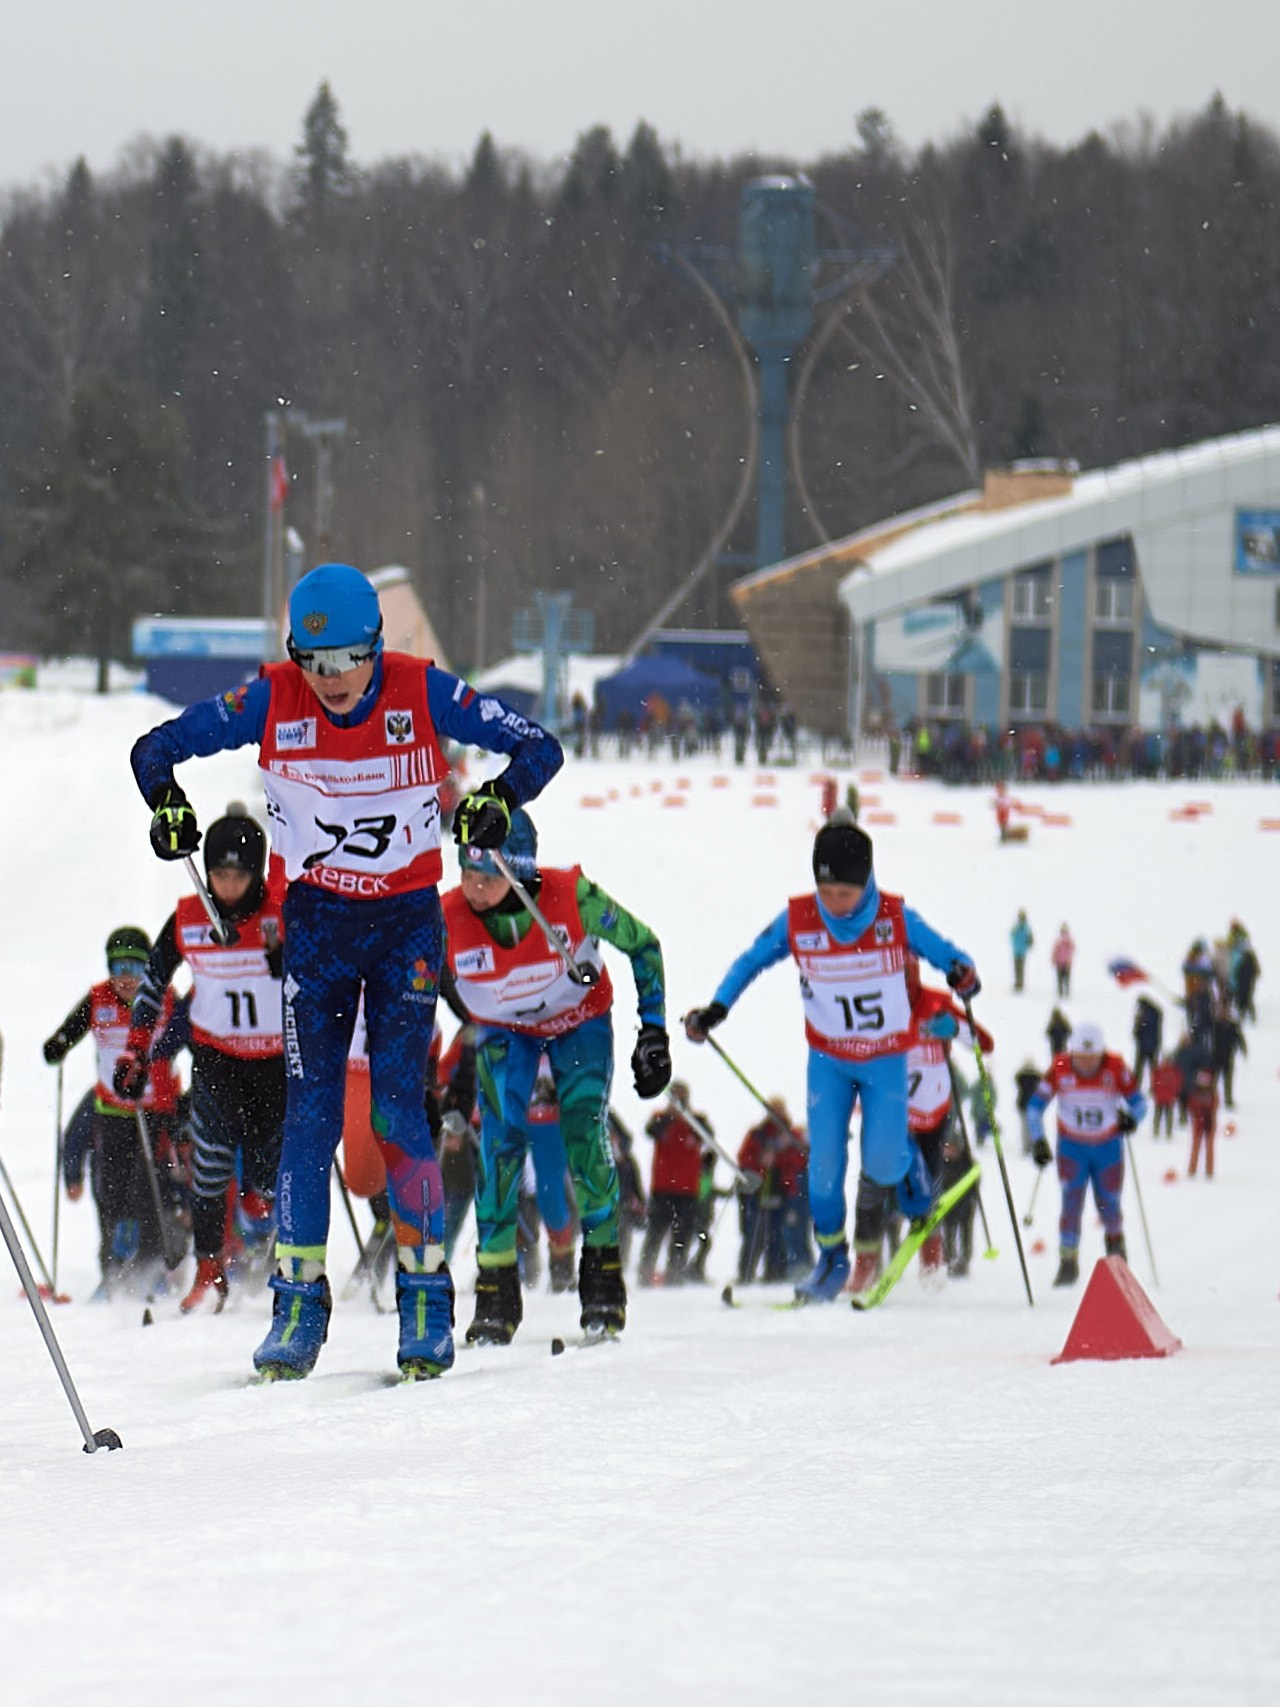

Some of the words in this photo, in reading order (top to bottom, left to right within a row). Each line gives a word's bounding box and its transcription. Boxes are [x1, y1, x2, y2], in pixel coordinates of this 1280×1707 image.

[302, 813, 397, 870] 23
[226, 990, 258, 1028] 11
[834, 990, 885, 1031] 15
